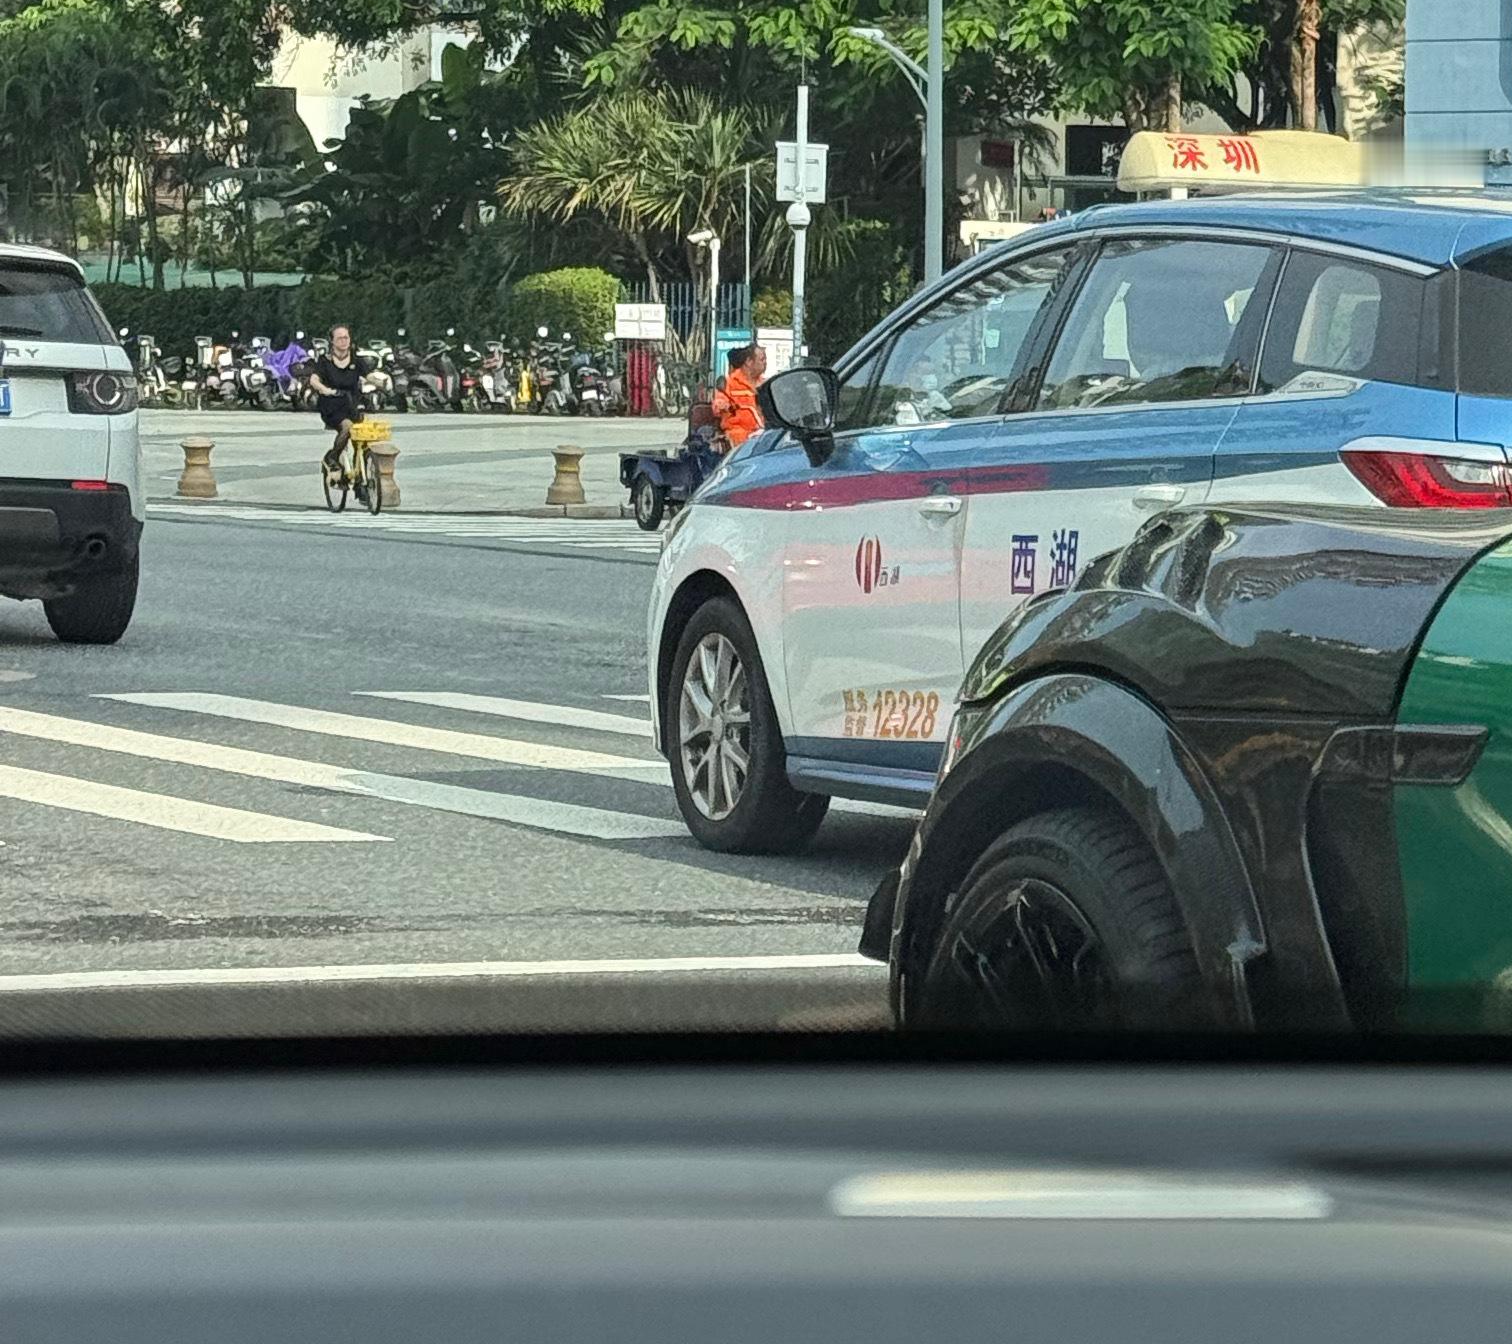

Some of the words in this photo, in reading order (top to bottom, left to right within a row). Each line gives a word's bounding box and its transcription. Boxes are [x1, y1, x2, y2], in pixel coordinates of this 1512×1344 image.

[1165, 137, 1260, 174] 深圳
[1011, 528, 1079, 594] 西湖
[873, 690, 939, 738] 12328
